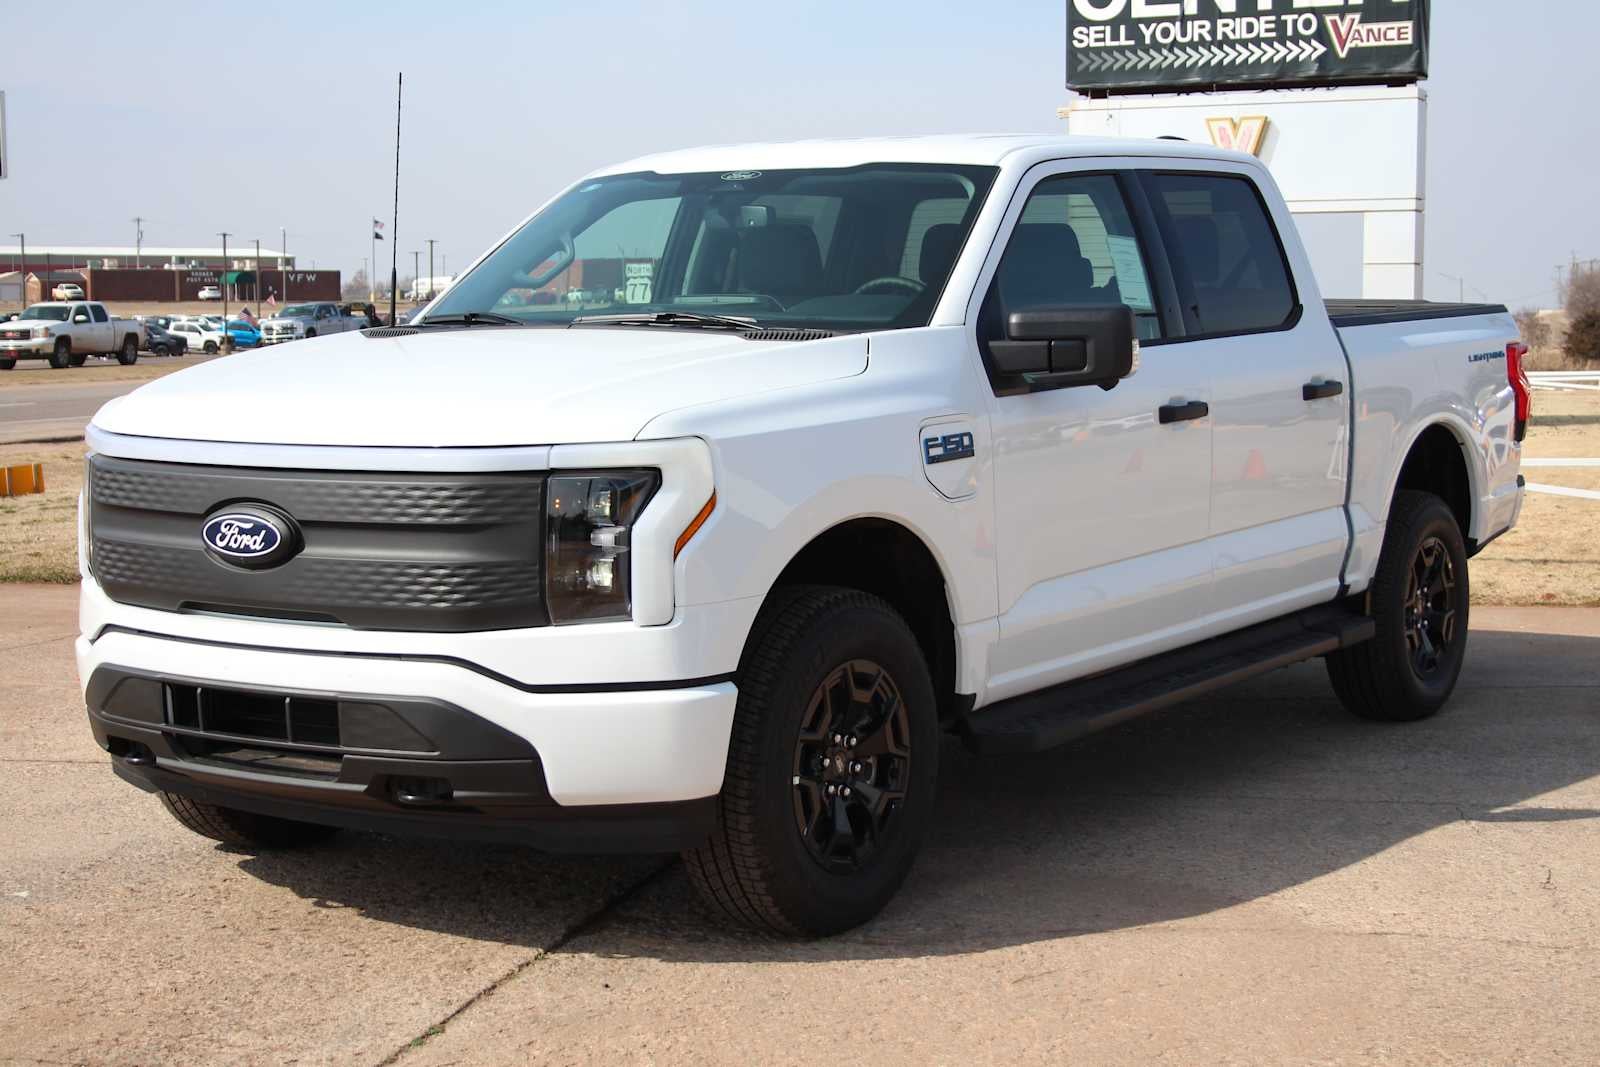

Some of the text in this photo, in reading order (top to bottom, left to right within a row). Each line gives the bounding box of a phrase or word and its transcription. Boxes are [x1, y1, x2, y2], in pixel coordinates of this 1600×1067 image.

[1072, 13, 1318, 48] SELL YOUR RIDE TO
[289, 273, 317, 283] VFW
[628, 283, 649, 300] 77
[216, 520, 267, 551] Ford
